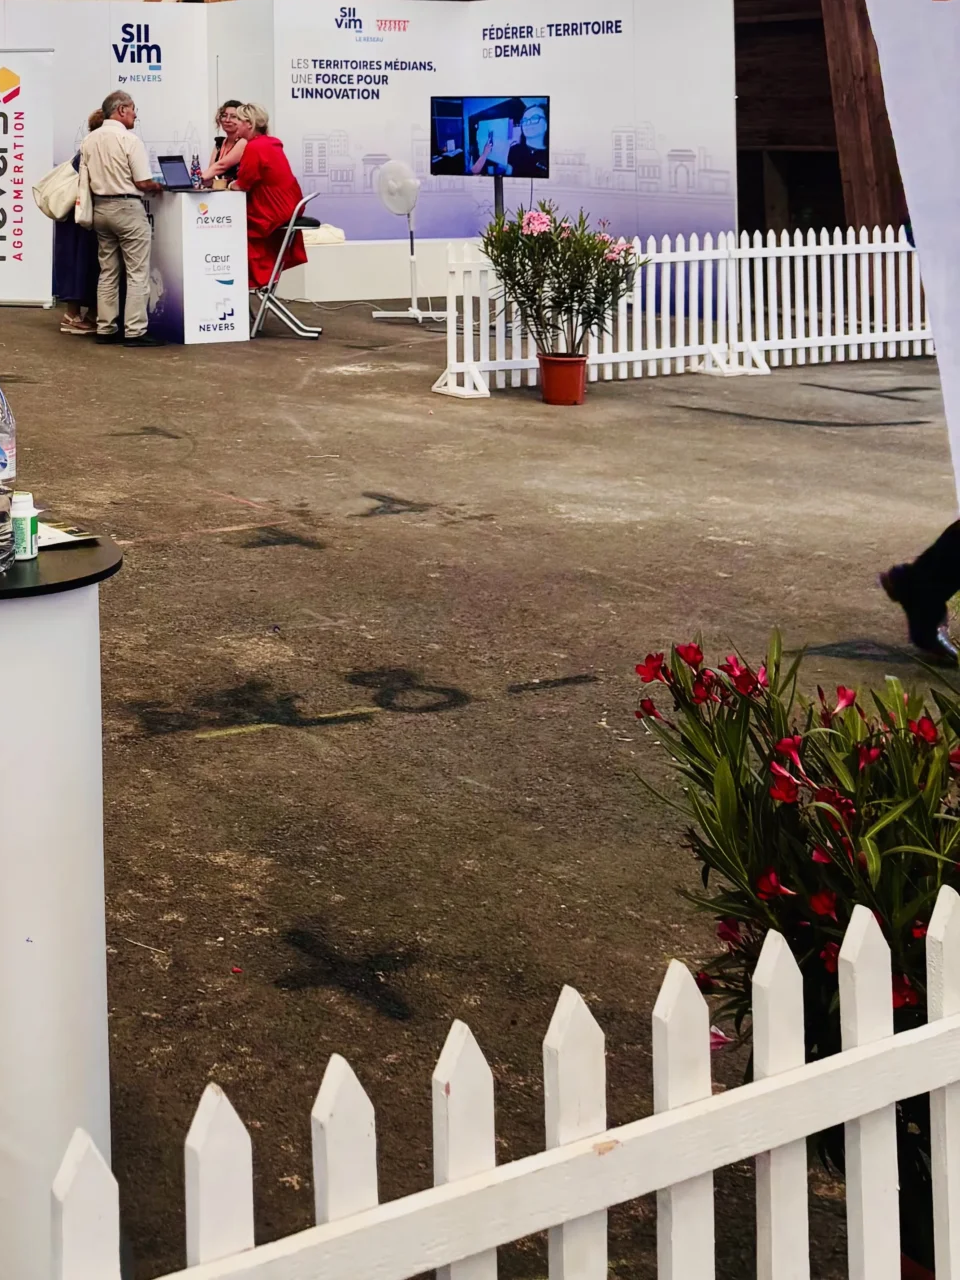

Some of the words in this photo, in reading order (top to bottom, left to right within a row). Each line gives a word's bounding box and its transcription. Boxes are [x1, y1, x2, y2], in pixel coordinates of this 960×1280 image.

[482, 23, 534, 41] FÉDÉRER
[535, 26, 546, 38] LE
[547, 20, 623, 37] TERRITOIRE
[482, 47, 494, 59] DE
[494, 43, 541, 58] DEMAIN
[291, 58, 309, 69] LES
[311, 59, 382, 71] TERRITOIRES
[384, 58, 437, 72] MÉDIANS,
[118, 74, 128, 84] by
[129, 74, 162, 82] NEVERS
[291, 73, 313, 84] UNE
[315, 73, 354, 85] FORCE
[356, 74, 389, 85] POUR
[291, 87, 380, 100] L'INNOVATION
[10, 111, 25, 262] AGGLOMÉRATION
[196, 215, 232, 224] nevers
[212, 263, 231, 272] Loire
[199, 322, 235, 332] NEVERS
